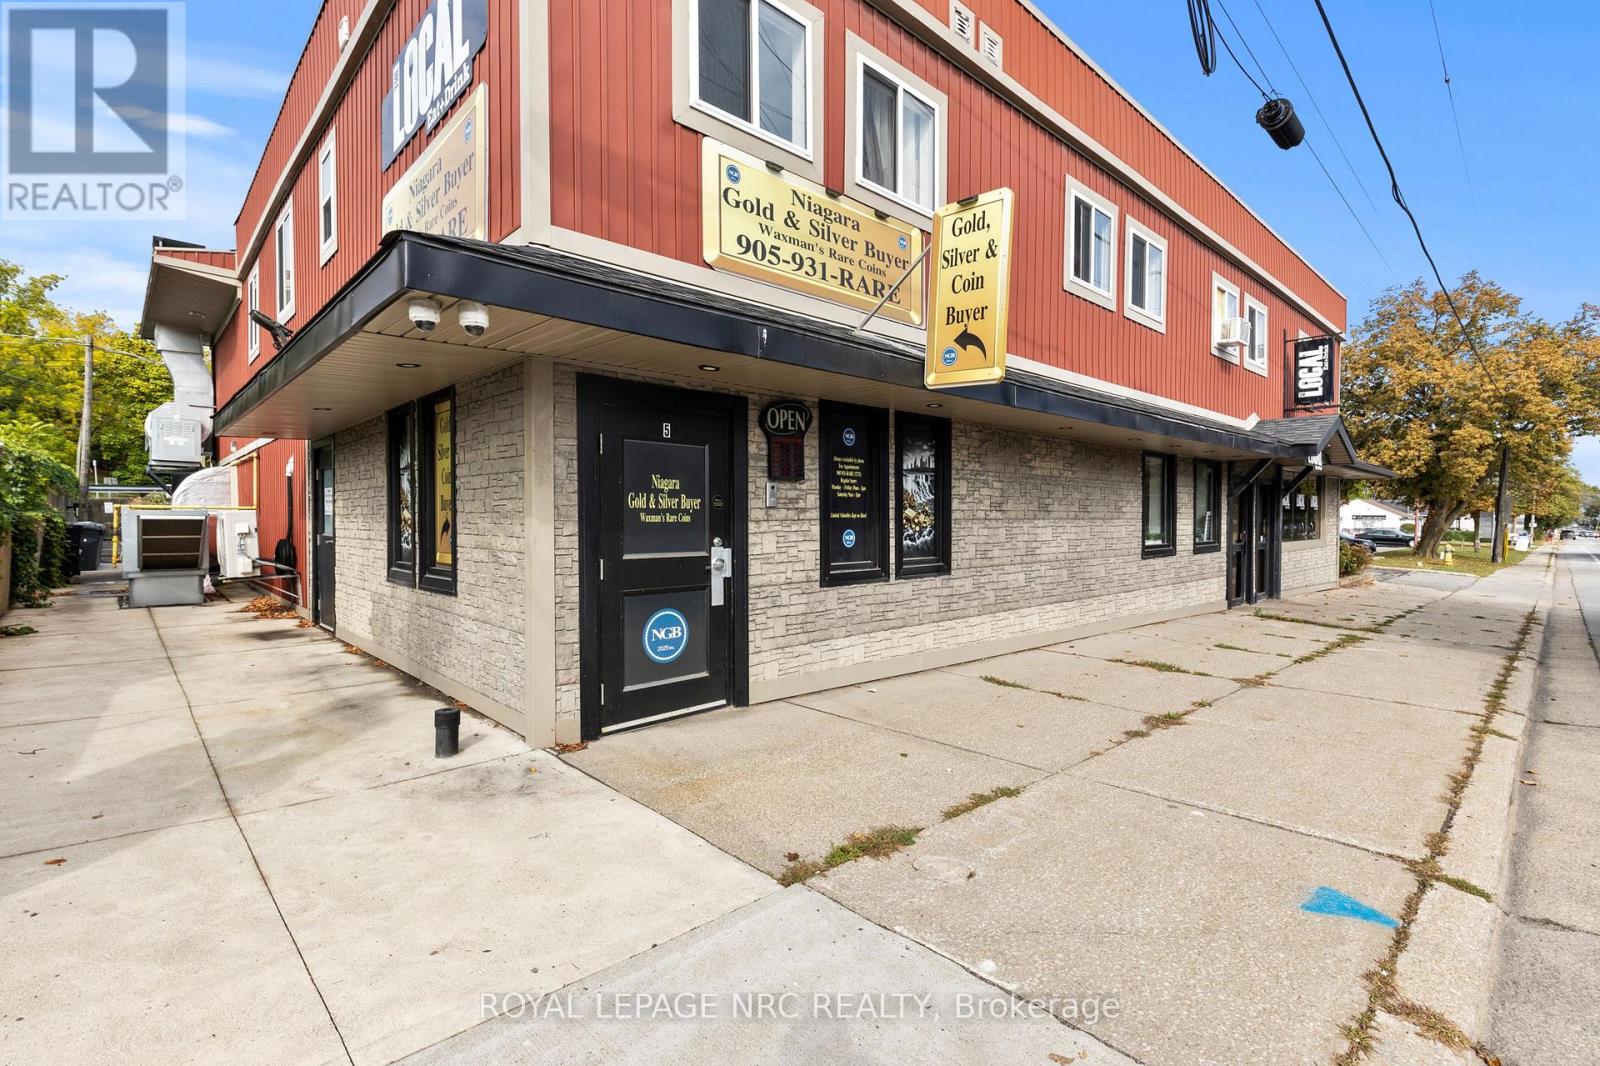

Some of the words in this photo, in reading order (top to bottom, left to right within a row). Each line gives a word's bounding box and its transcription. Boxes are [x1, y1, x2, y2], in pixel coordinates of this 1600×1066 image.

[393, 0, 469, 153] LOCAL
[409, 158, 442, 203] Niagara
[416, 187, 441, 222] Silver
[443, 152, 475, 196] Buyer
[440, 196, 458, 219] Coins
[791, 189, 861, 232] Niagara
[722, 186, 775, 222] Gold
[783, 210, 801, 231] &
[808, 219, 858, 251] Silver
[863, 239, 909, 271] Buyer
[952, 210, 990, 238] Gold,
[758, 222, 825, 256] Waxman's
[829, 248, 855, 266] Rare
[858, 260, 887, 278] Coins
[942, 247, 980, 270] Silver
[985, 238, 998, 260] &
[736, 234, 901, 305] 905-931-RARE
[951, 272, 984, 295] Coin
[945, 304, 988, 328] Buyer
[1298, 345, 1323, 398] LOCAL
[767, 407, 805, 431] OPEN
[651, 474, 680, 493] Niagara
[628, 492, 647, 509] Gold
[649, 493, 656, 509] &
[658, 493, 679, 509] Silver
[681, 494, 701, 513] Buyer
[640, 512, 665, 522] Waxman's
[666, 512, 677, 522] Rare
[678, 512, 691, 522] Coins
[651, 626, 682, 642] NGB
